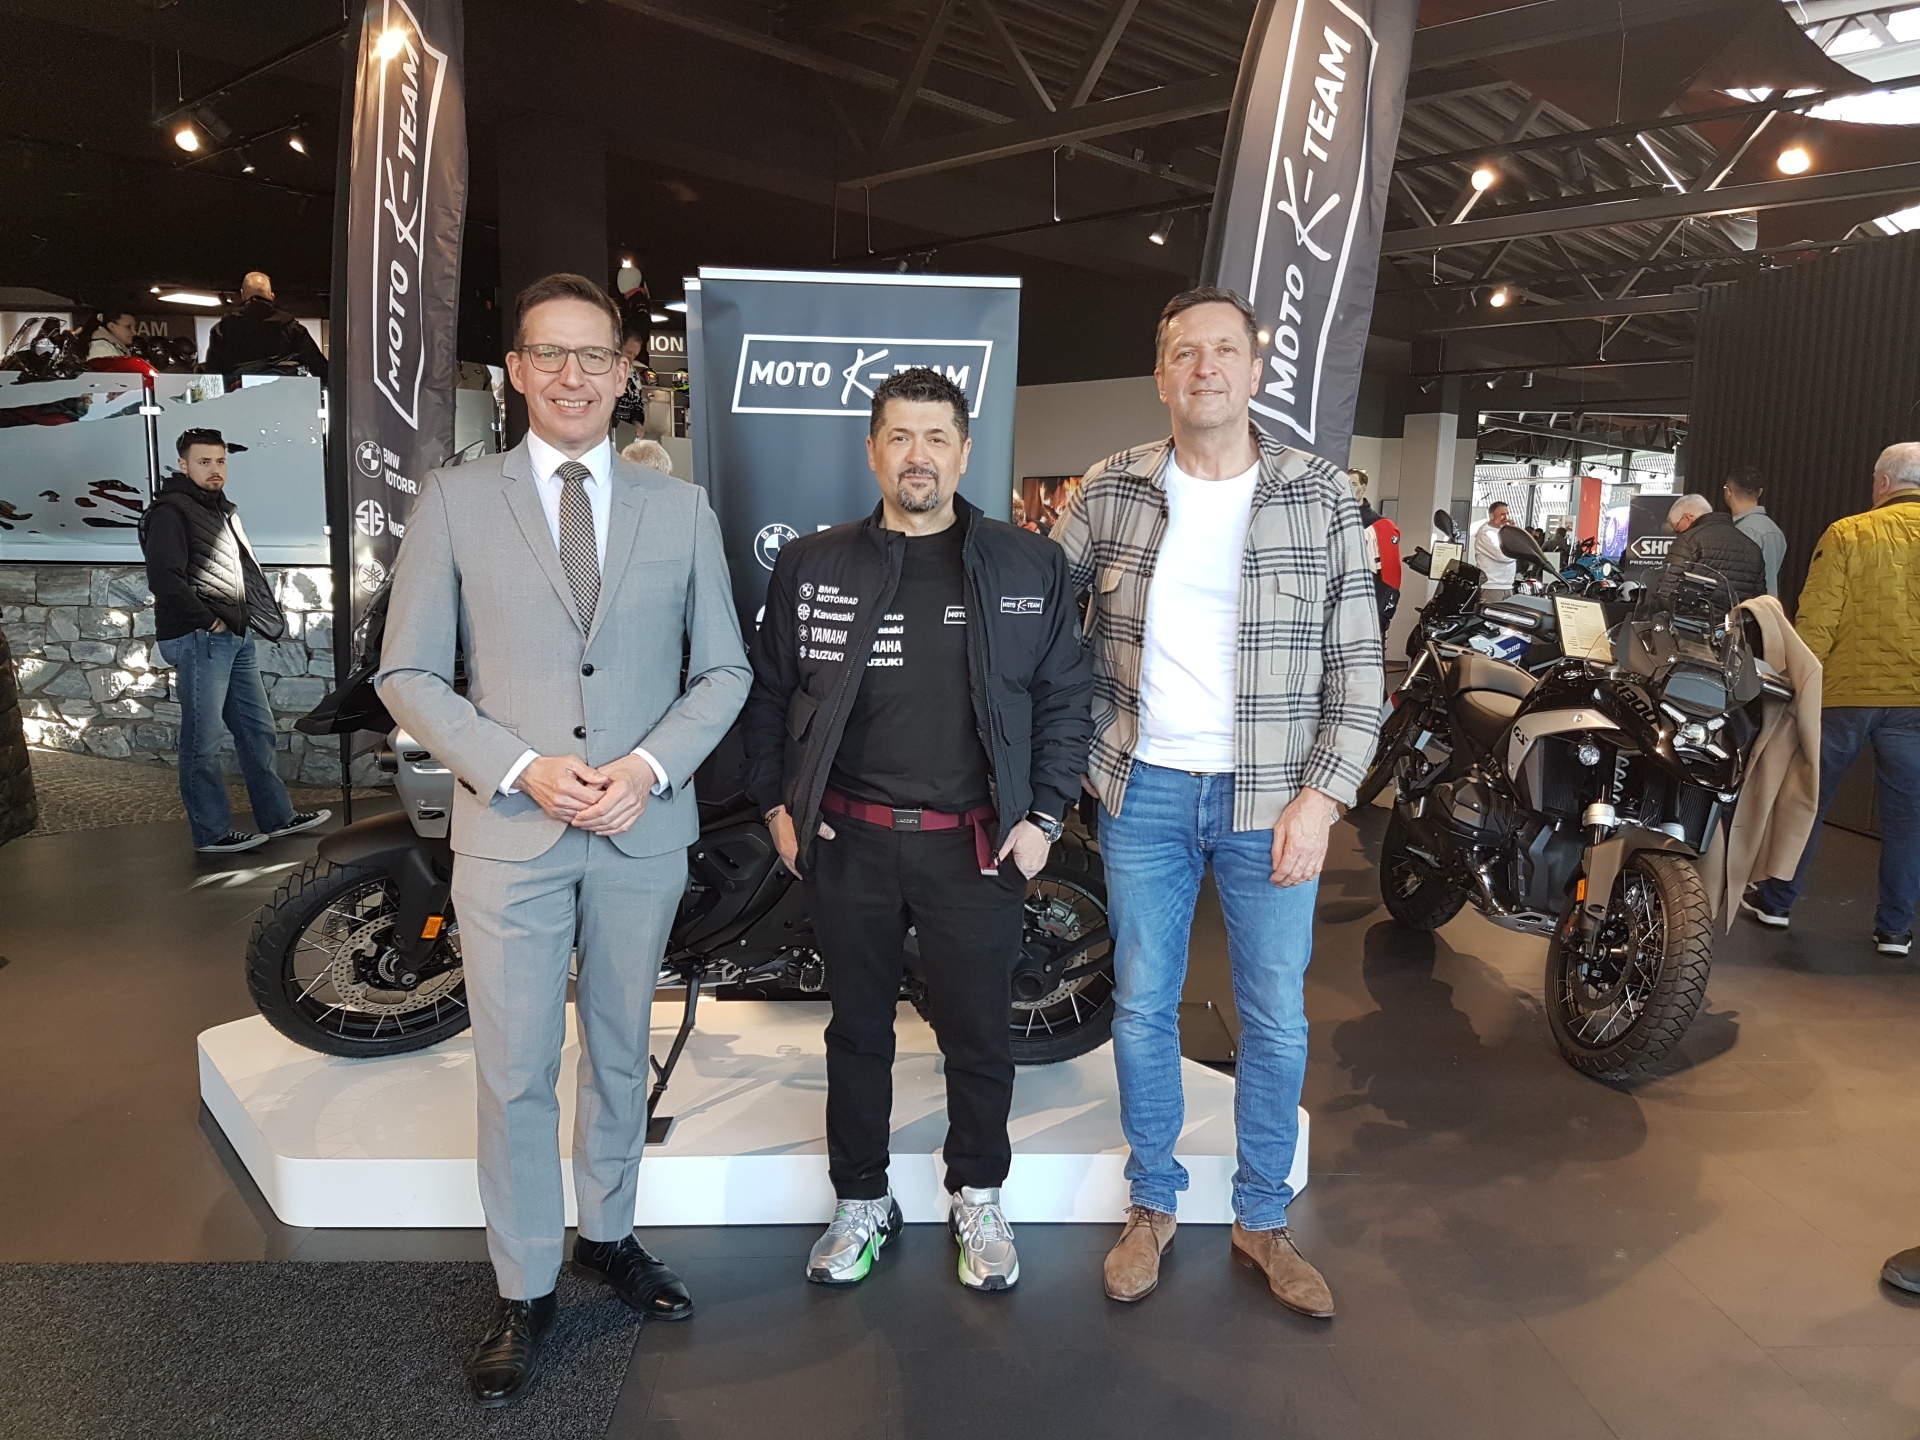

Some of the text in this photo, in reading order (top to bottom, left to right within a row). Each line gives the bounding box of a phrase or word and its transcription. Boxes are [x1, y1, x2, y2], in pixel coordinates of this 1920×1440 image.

[388, 264, 409, 393] MOTO
[1264, 264, 1306, 405] MOTO
[649, 335, 684, 352] ION
[749, 360, 832, 387] MOTO
[383, 447, 400, 470] BMW
[760, 526, 796, 540] BMW
[818, 585, 840, 594] BMW
[816, 595, 859, 606] MOTORRAD
[813, 608, 855, 622] Kawasaki
[811, 627, 848, 645] YAMAHA
[808, 648, 845, 662] SUZUKI
